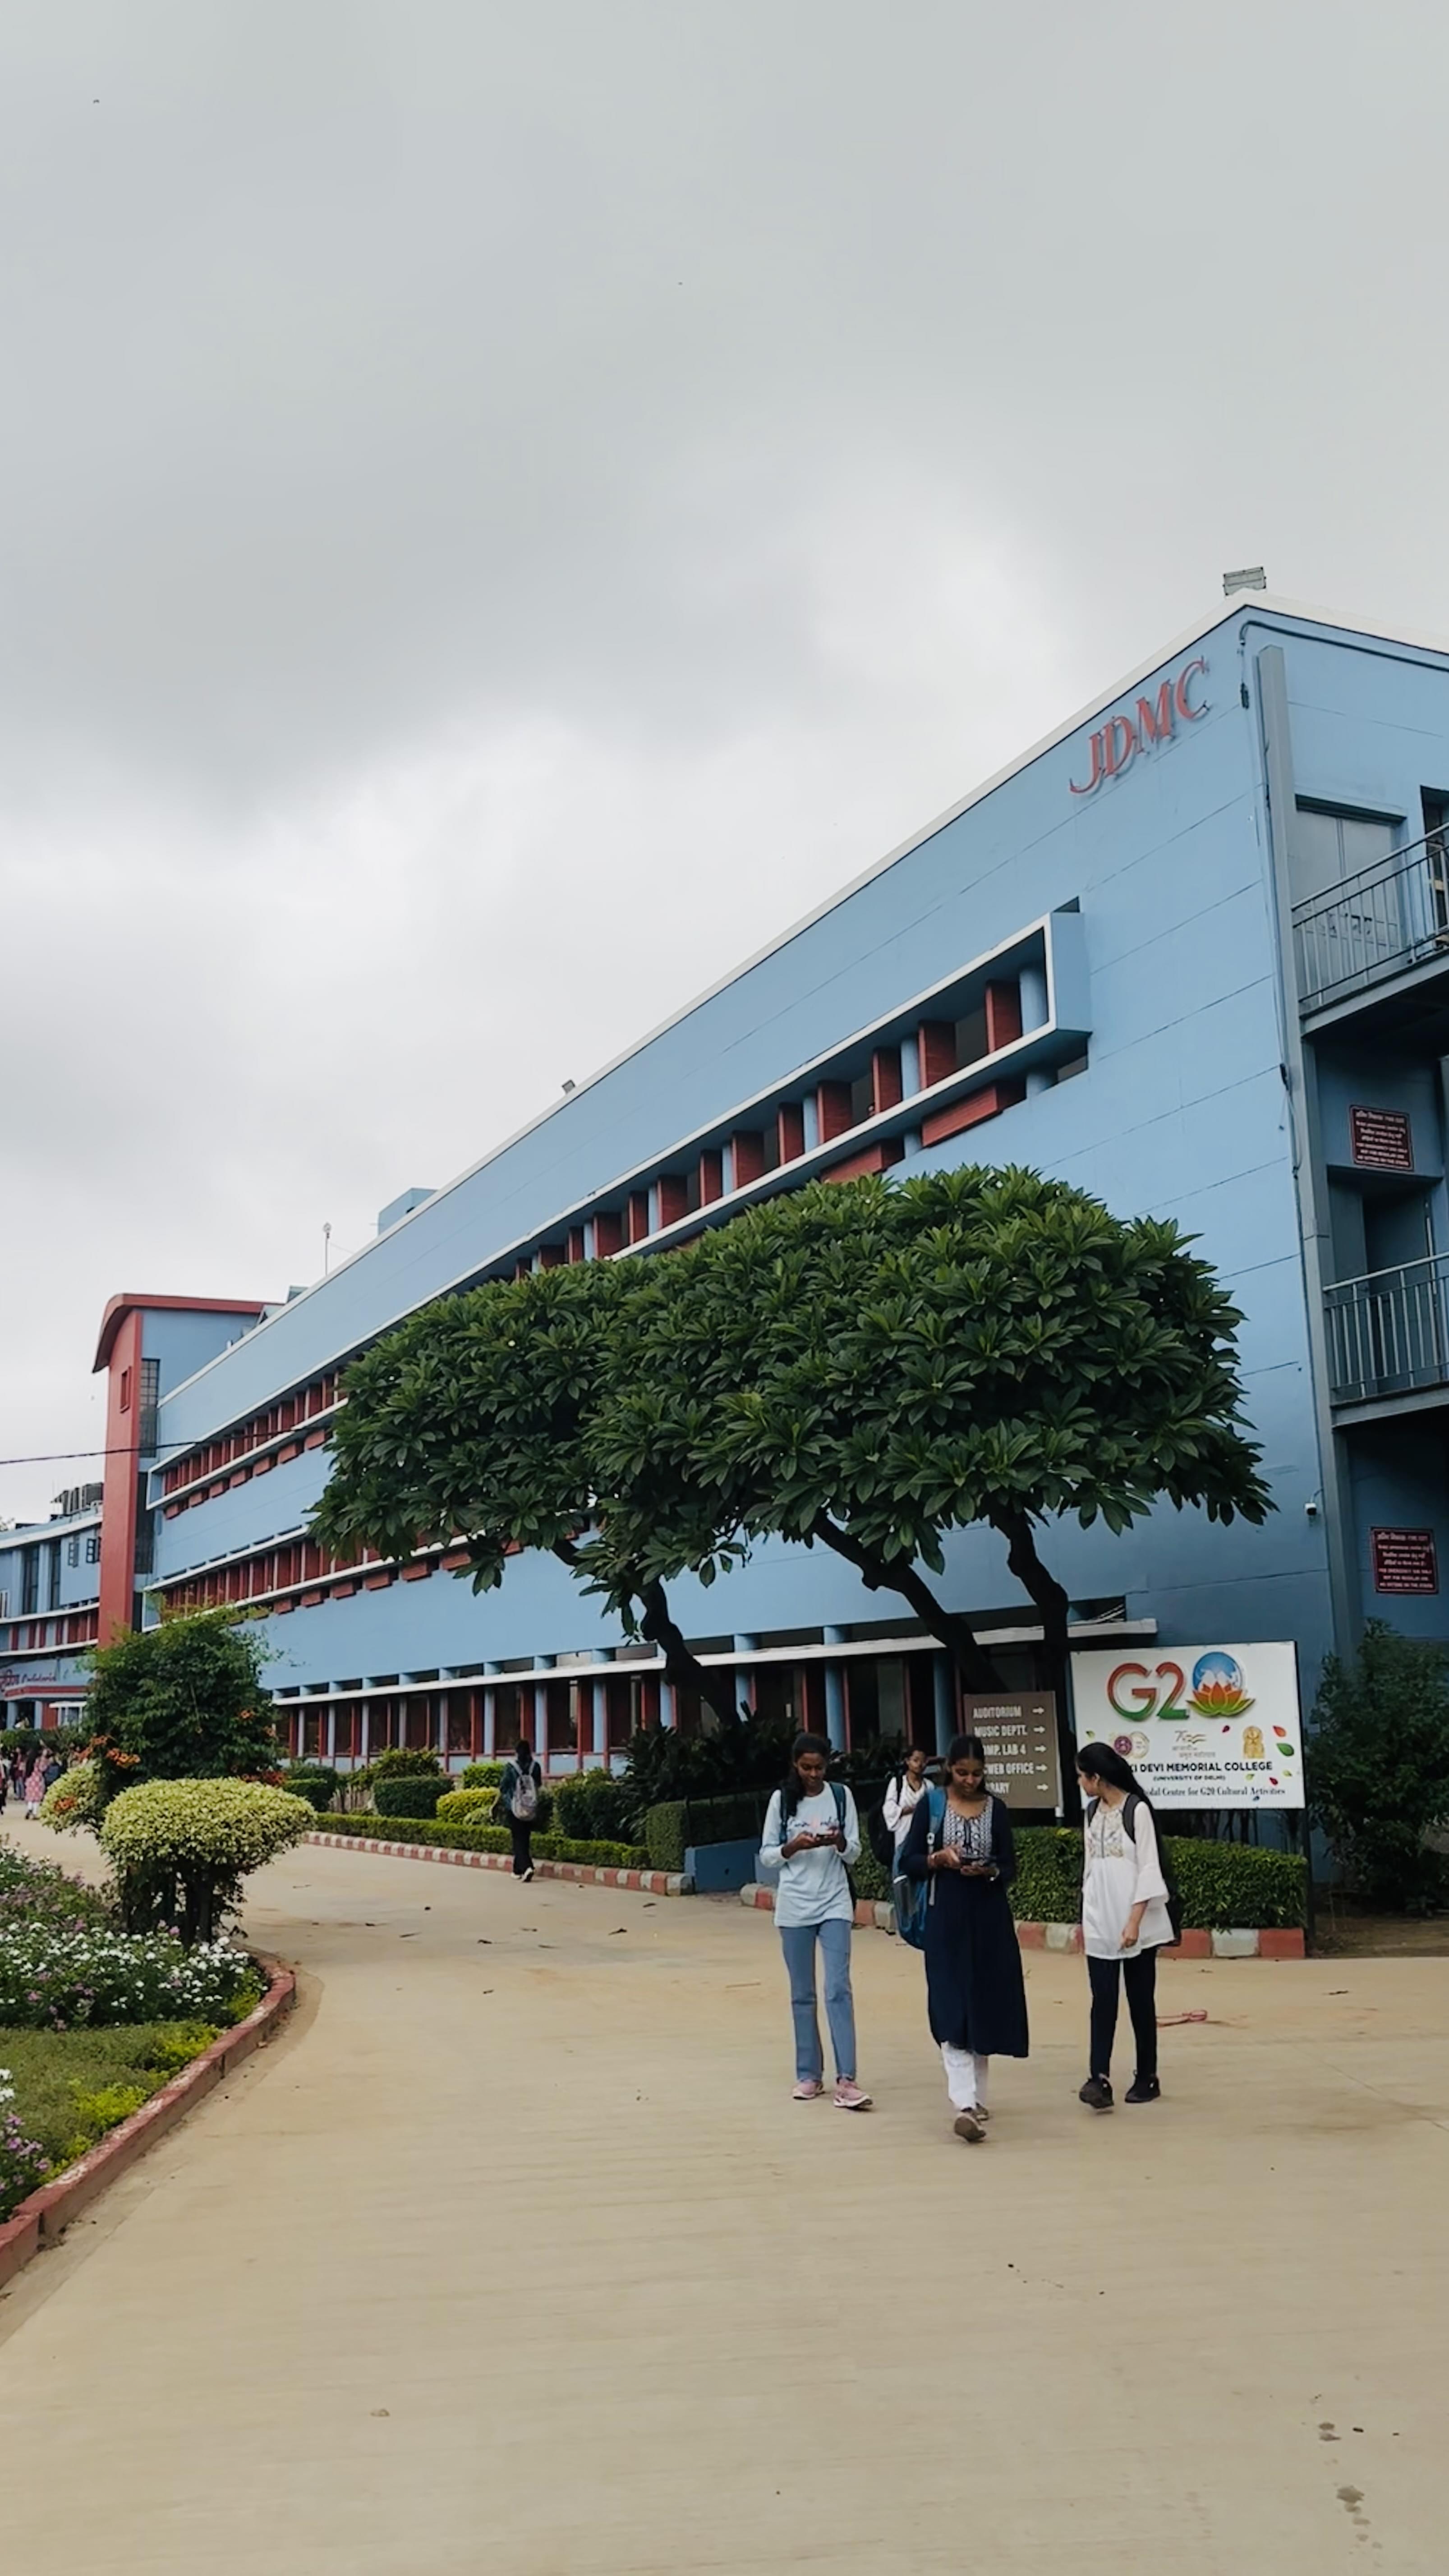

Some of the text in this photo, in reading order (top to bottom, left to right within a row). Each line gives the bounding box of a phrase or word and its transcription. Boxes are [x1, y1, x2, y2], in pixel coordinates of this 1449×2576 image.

[1069, 655, 1211, 795] JDMC
[973, 1707, 1021, 1718] AUDITORIUM
[974, 1726, 999, 1737] MUSIC
[1002, 1744, 1019, 1755] LAB
[1020, 1744, 1026, 1755] 4
[1006, 1762, 1034, 1774] OFFICE
[1140, 1763, 1164, 1772] DEVI
[1167, 1762, 1222, 1772] MEMORIAL
[1224, 1761, 1273, 1771] COLLEGE
[1162, 1787, 1186, 1796] Centre
[1187, 1786, 1199, 1795] for
[1200, 1786, 1215, 1795] G20
[1217, 1786, 1248, 1796] Cultural
[1250, 1787, 1286, 1795] Activities
